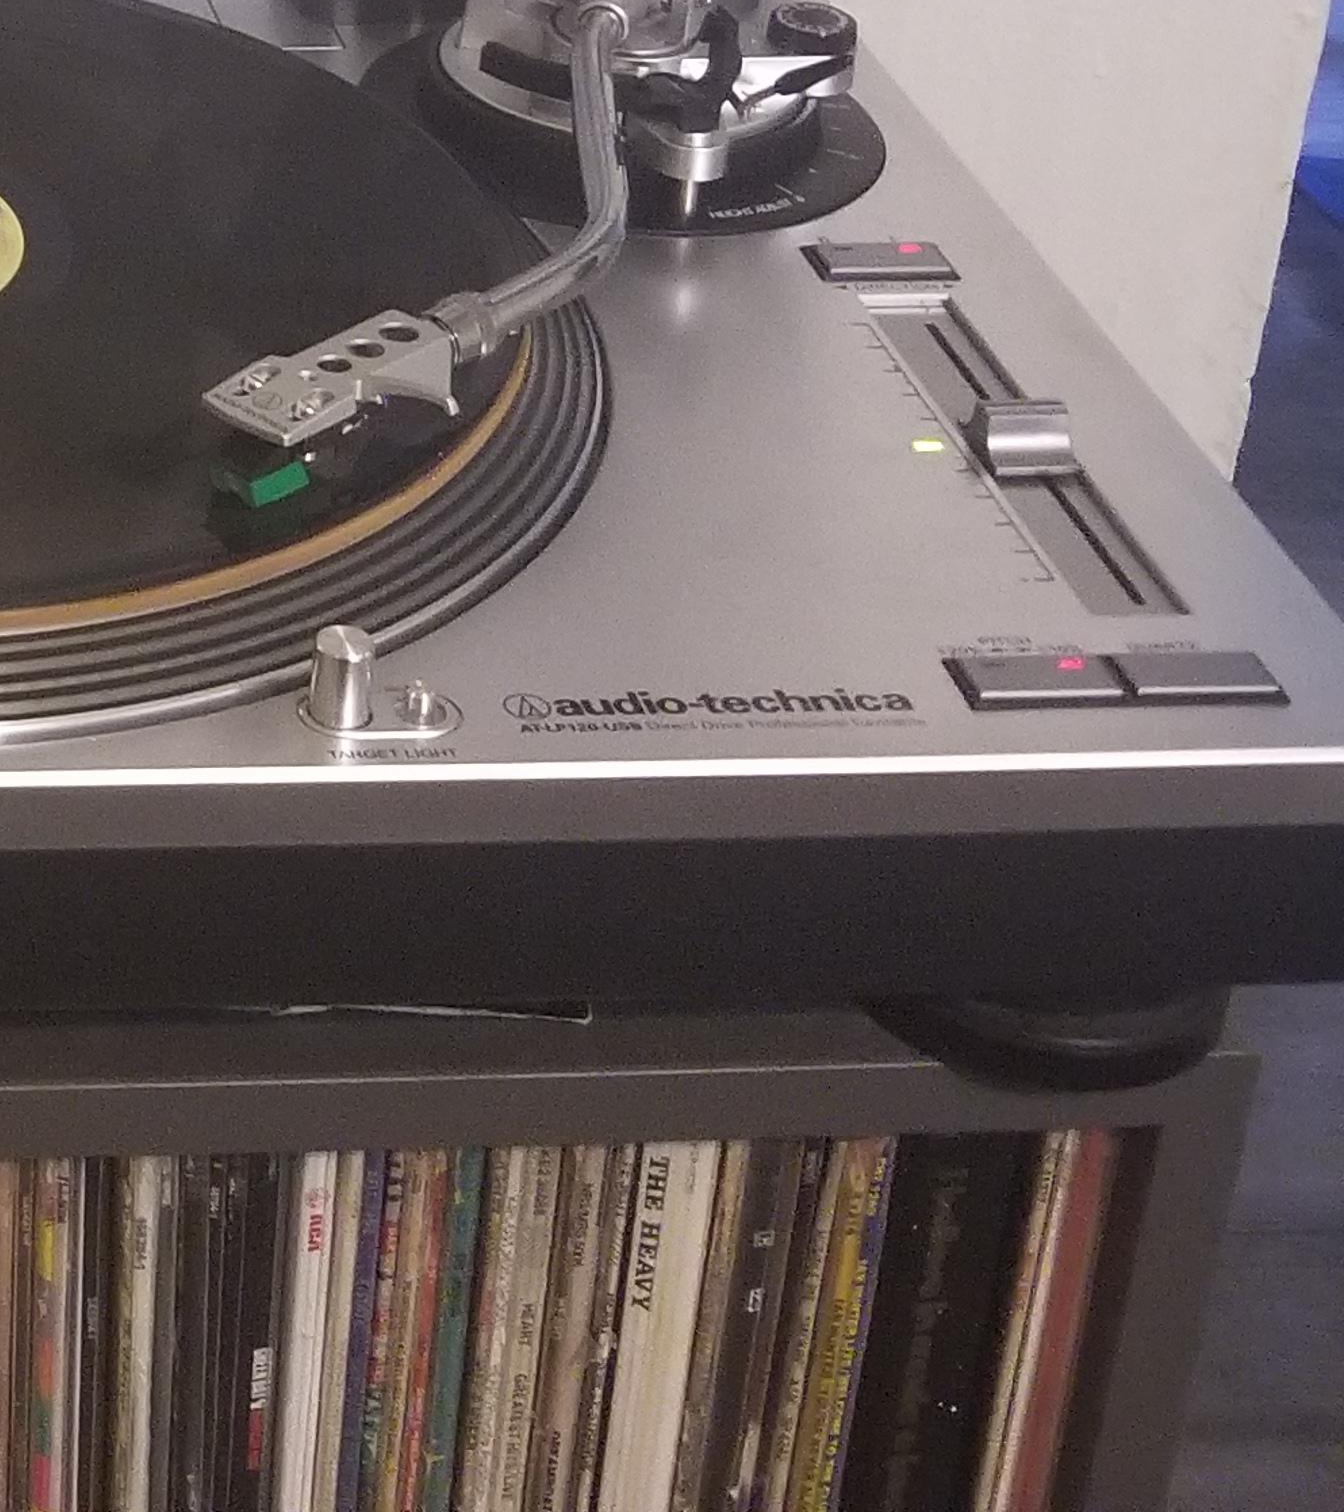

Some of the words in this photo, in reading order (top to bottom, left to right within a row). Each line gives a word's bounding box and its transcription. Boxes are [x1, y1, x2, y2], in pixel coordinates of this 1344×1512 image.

[553, 687, 914, 717] audio-technica
[642, 1155, 670, 1212] THE
[632, 1219, 664, 1313] HEAVY
